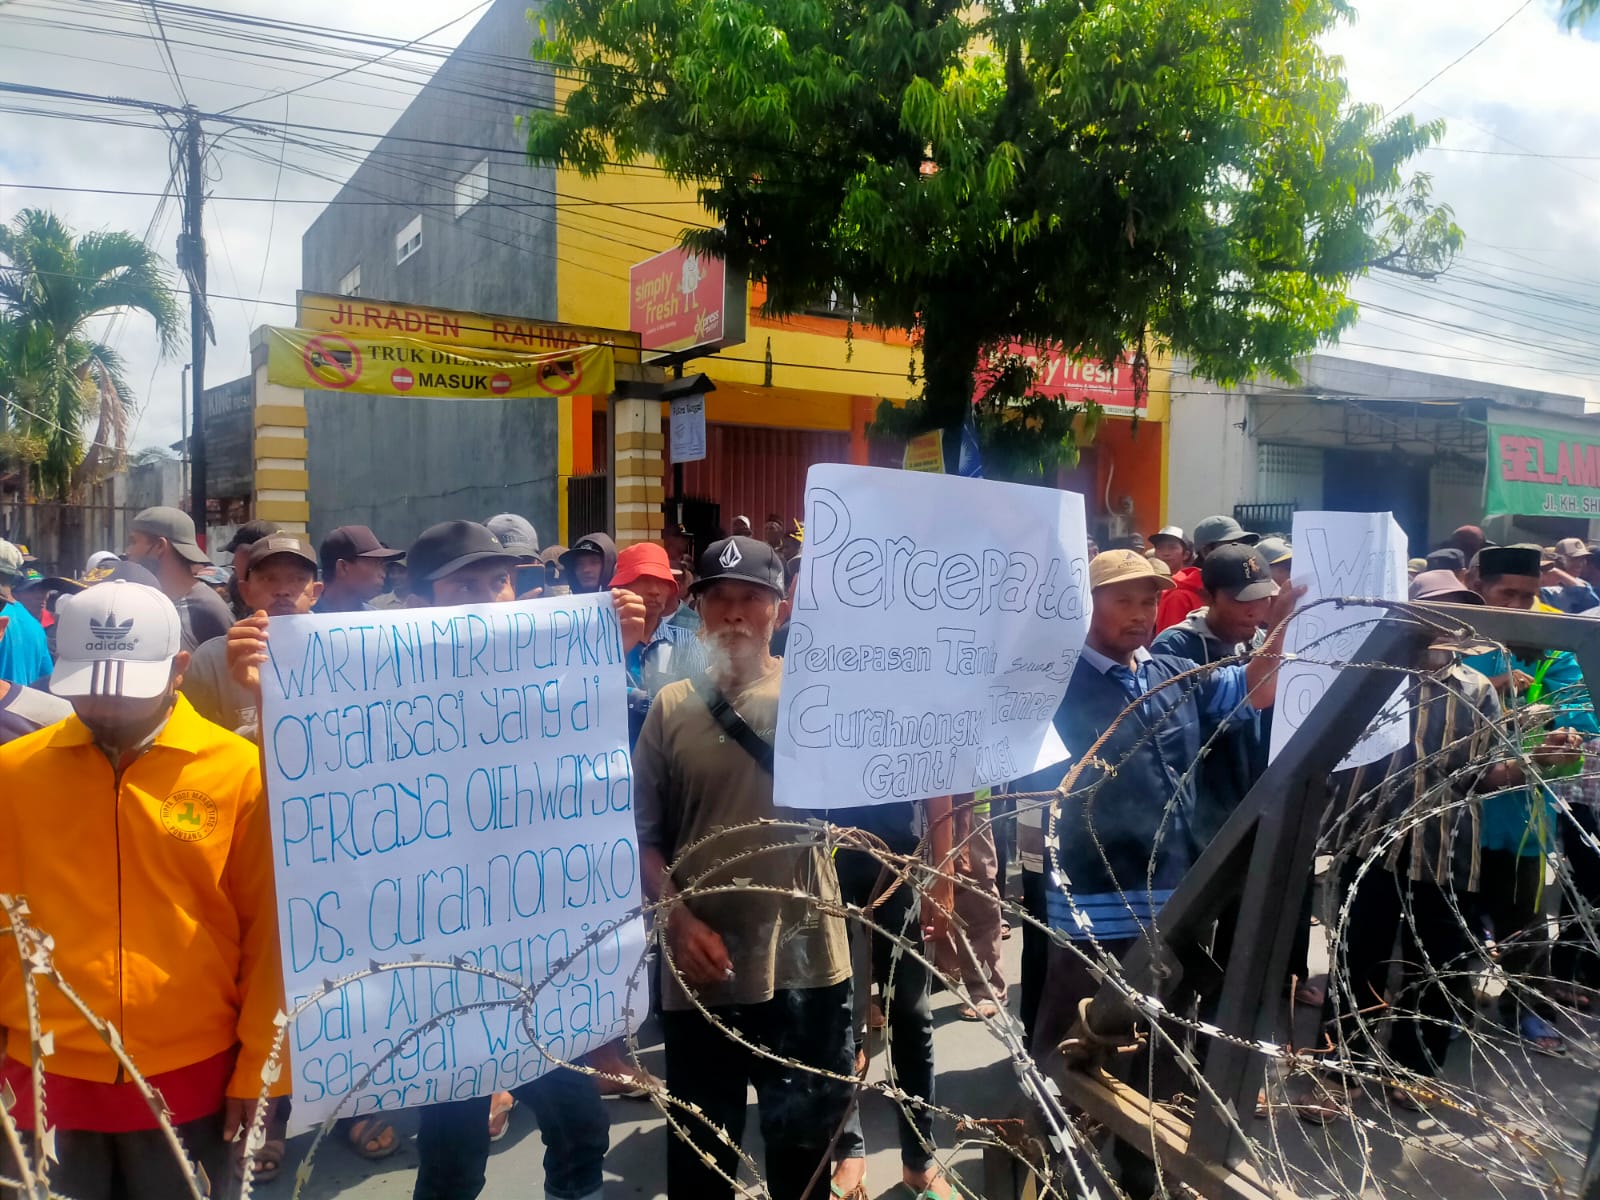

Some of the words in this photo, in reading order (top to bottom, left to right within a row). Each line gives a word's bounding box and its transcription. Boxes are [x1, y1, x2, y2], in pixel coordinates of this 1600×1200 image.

[635, 271, 673, 303] simply
[646, 292, 679, 325] fresh
[368, 345, 425, 363] TRUK
[419, 373, 488, 390] MASUK
[1499, 434, 1600, 489] SELAM
[85, 640, 135, 651] adidas
[266, 622, 425, 700] WARTANI
[787, 622, 932, 675] Pelepasan
[478, 678, 562, 746] yang
[571, 674, 601, 732] di
[788, 684, 983, 750] Curahnongk
[862, 746, 959, 800] Ganti
[288, 890, 355, 974] DS.
